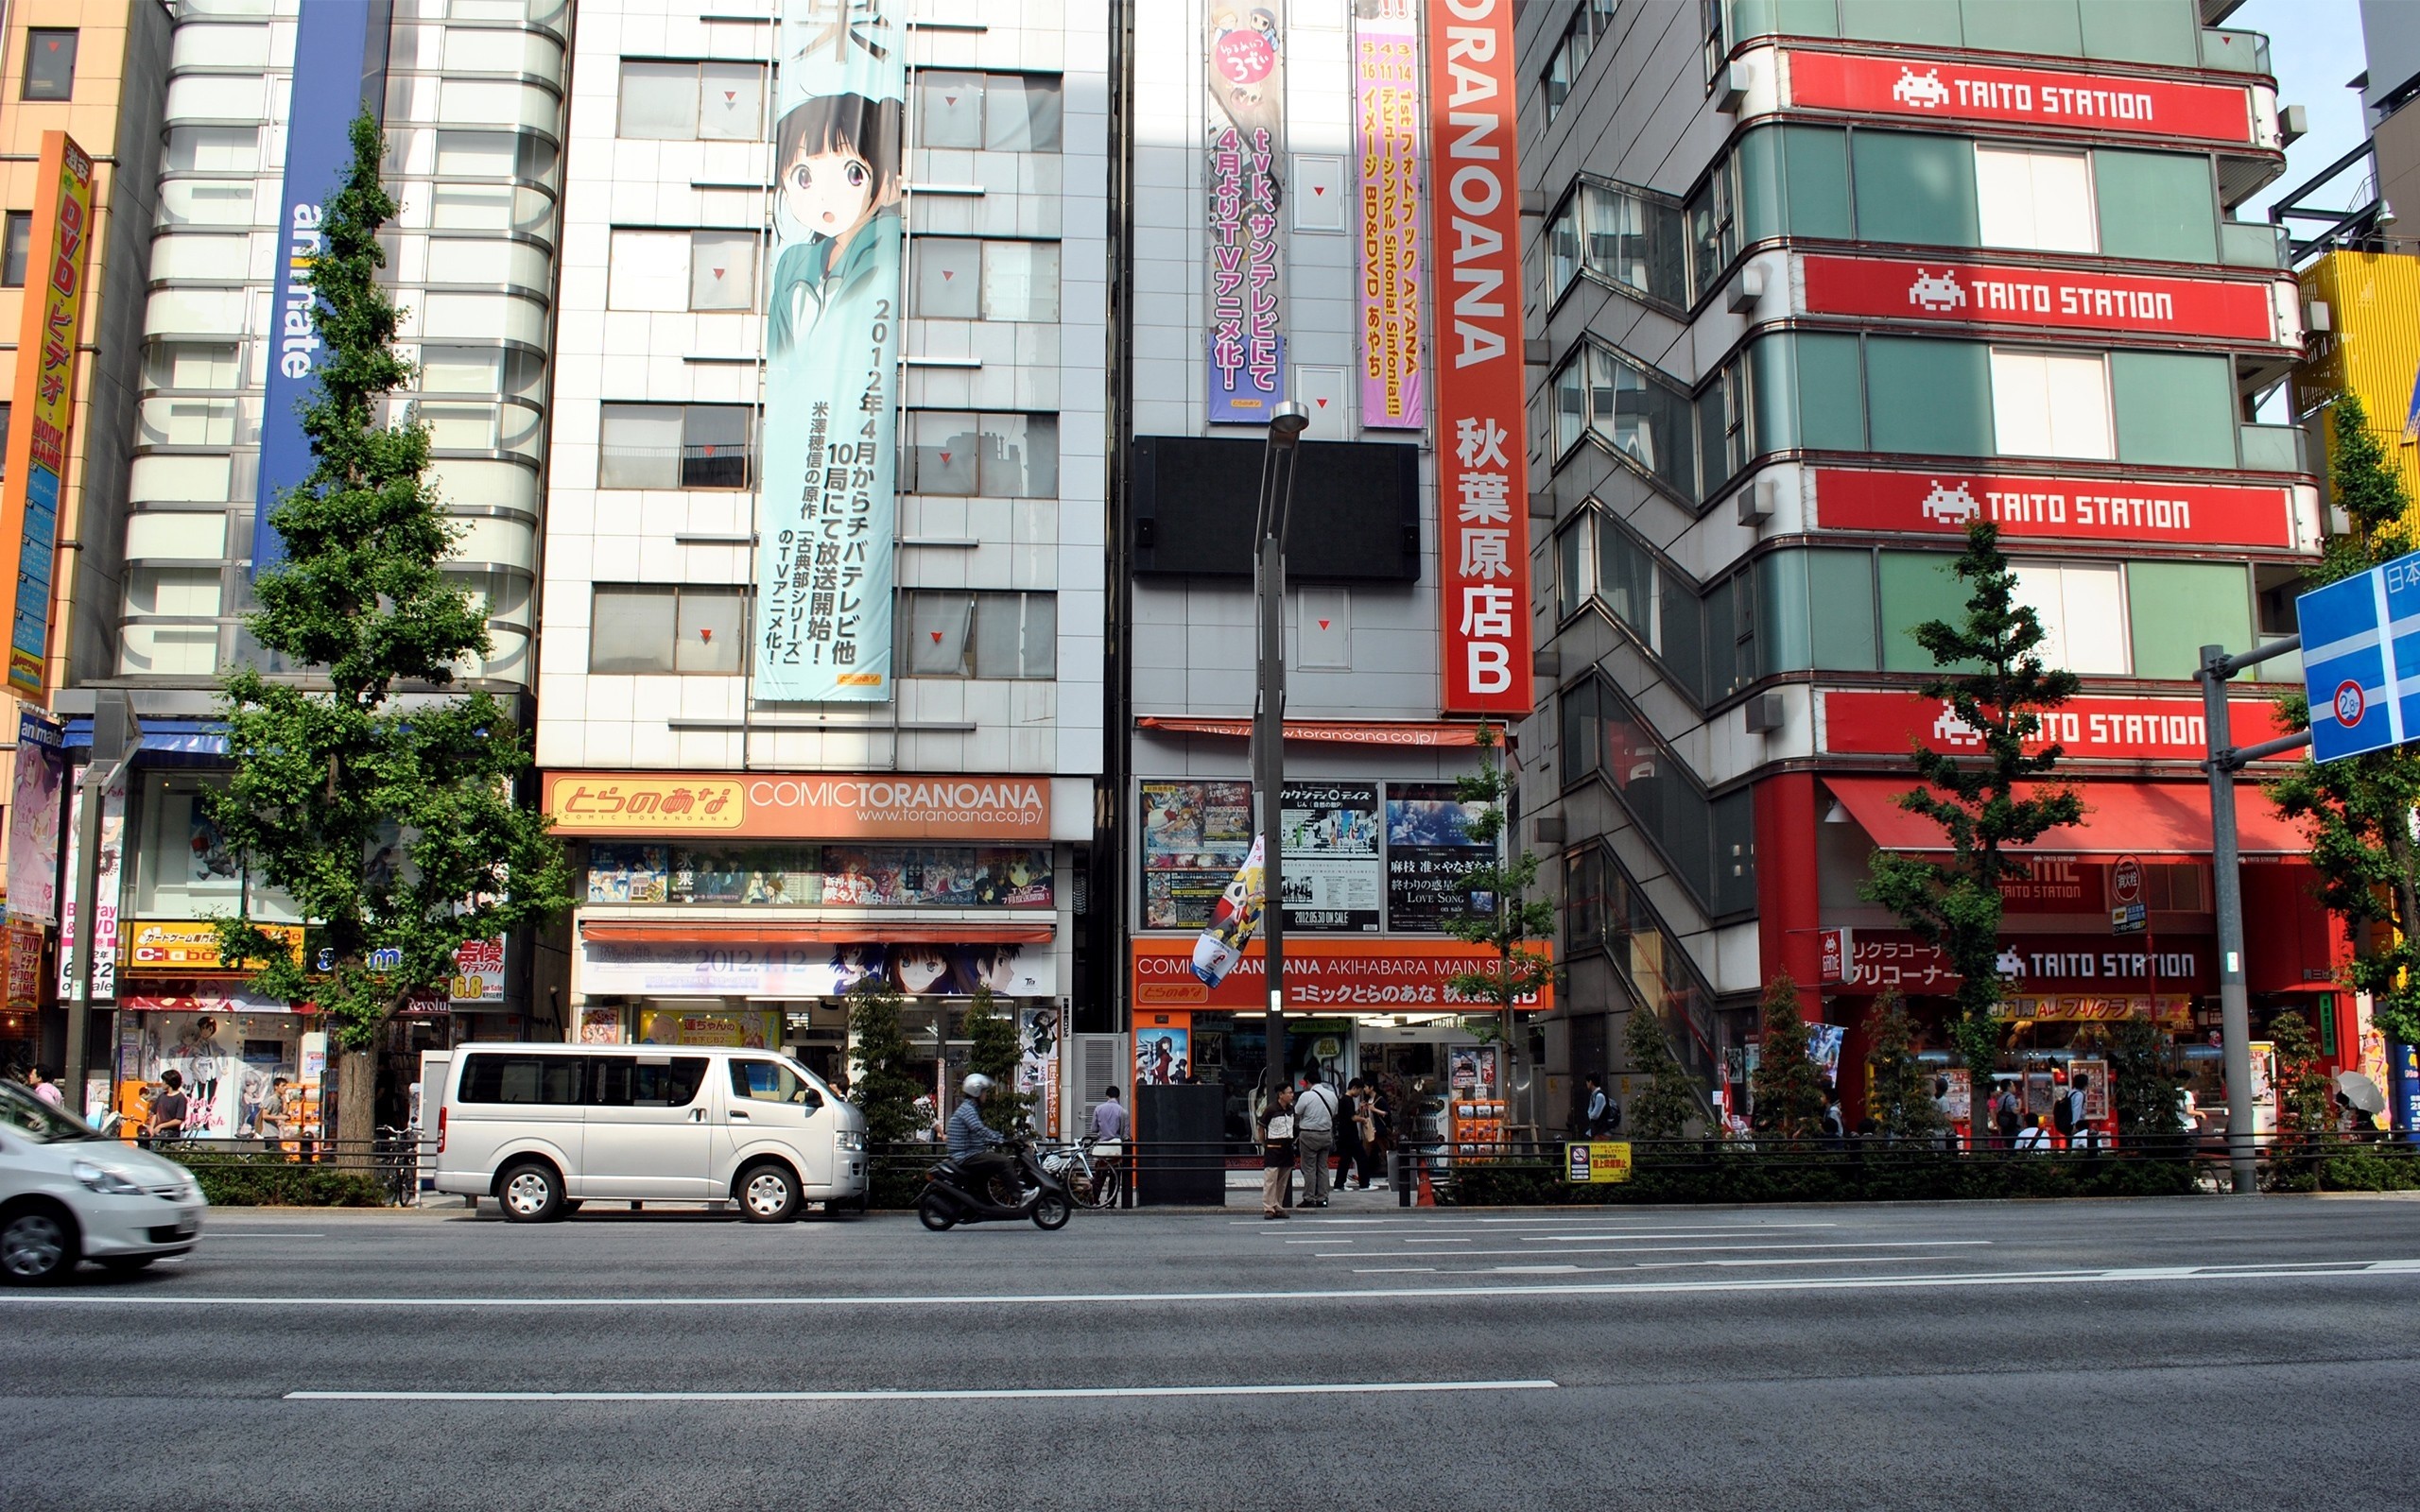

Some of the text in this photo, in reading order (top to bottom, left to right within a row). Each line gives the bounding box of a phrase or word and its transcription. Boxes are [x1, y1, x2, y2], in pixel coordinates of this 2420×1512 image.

[1954, 79, 2153, 121] TAITO STATION
[1971, 281, 2173, 320] TAITO STATION
[32, 415, 64, 451] BOOK
[31, 438, 62, 472] GAME
[1986, 491, 2190, 529] TAITO STATION
[1456, 417, 1513, 695] 秋葉原店B
[21, 720, 62, 747] animate
[1996, 712, 2205, 746] ITO STATION
[564, 786, 732, 815] とらのあな
[564, 813, 729, 822] COMIC TORANOANA
[856, 807, 1044, 826] www.toranoana.co.jp/
[676, 851, 695, 886] 氷菓
[2118, 871, 2138, 888] 消火栓
[1392, 879, 1460, 891] 終わりの惑星
[1997, 885, 2081, 898] TAITO STATION
[695, 948, 808, 973] 2012.4.12
[1326, 958, 1427, 975] AKIHABARA
[1434, 959, 1481, 975] MAIN
[2031, 954, 2195, 978] TAITO STATION
[9, 981, 36, 993] GAME
[453, 975, 482, 999] 6.8
[1291, 984, 1436, 1004] コミックとらのあな
[2037, 996, 2062, 1019] ALL
[2063, 997, 2127, 1019] プリクラ
